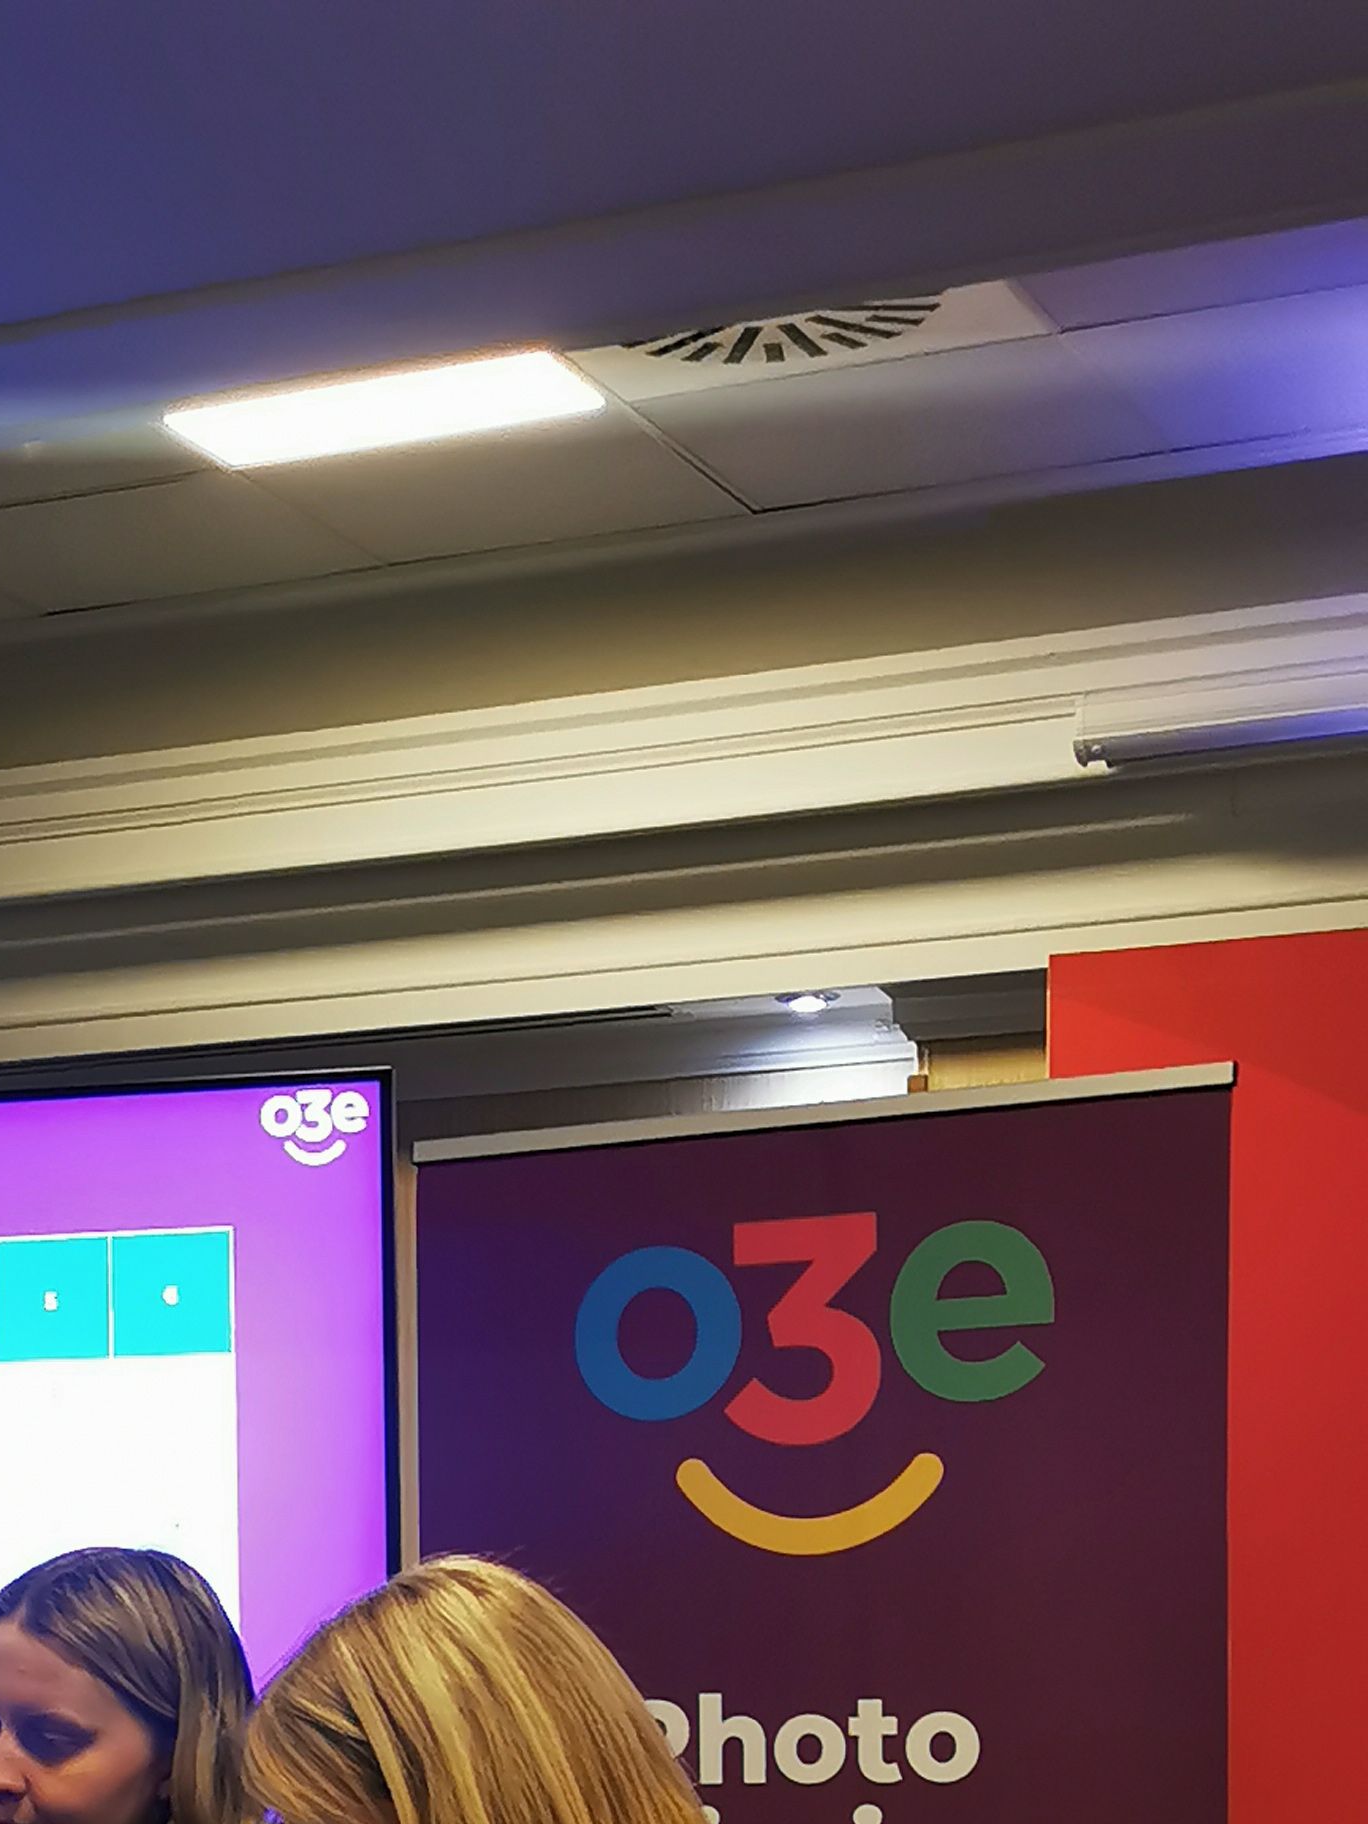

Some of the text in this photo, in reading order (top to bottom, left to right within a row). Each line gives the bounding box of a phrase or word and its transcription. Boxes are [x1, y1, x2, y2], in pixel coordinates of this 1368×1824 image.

[43, 1291, 58, 1311] 5
[162, 1285, 179, 1305] 6
[574, 1211, 1055, 1446] o3e
